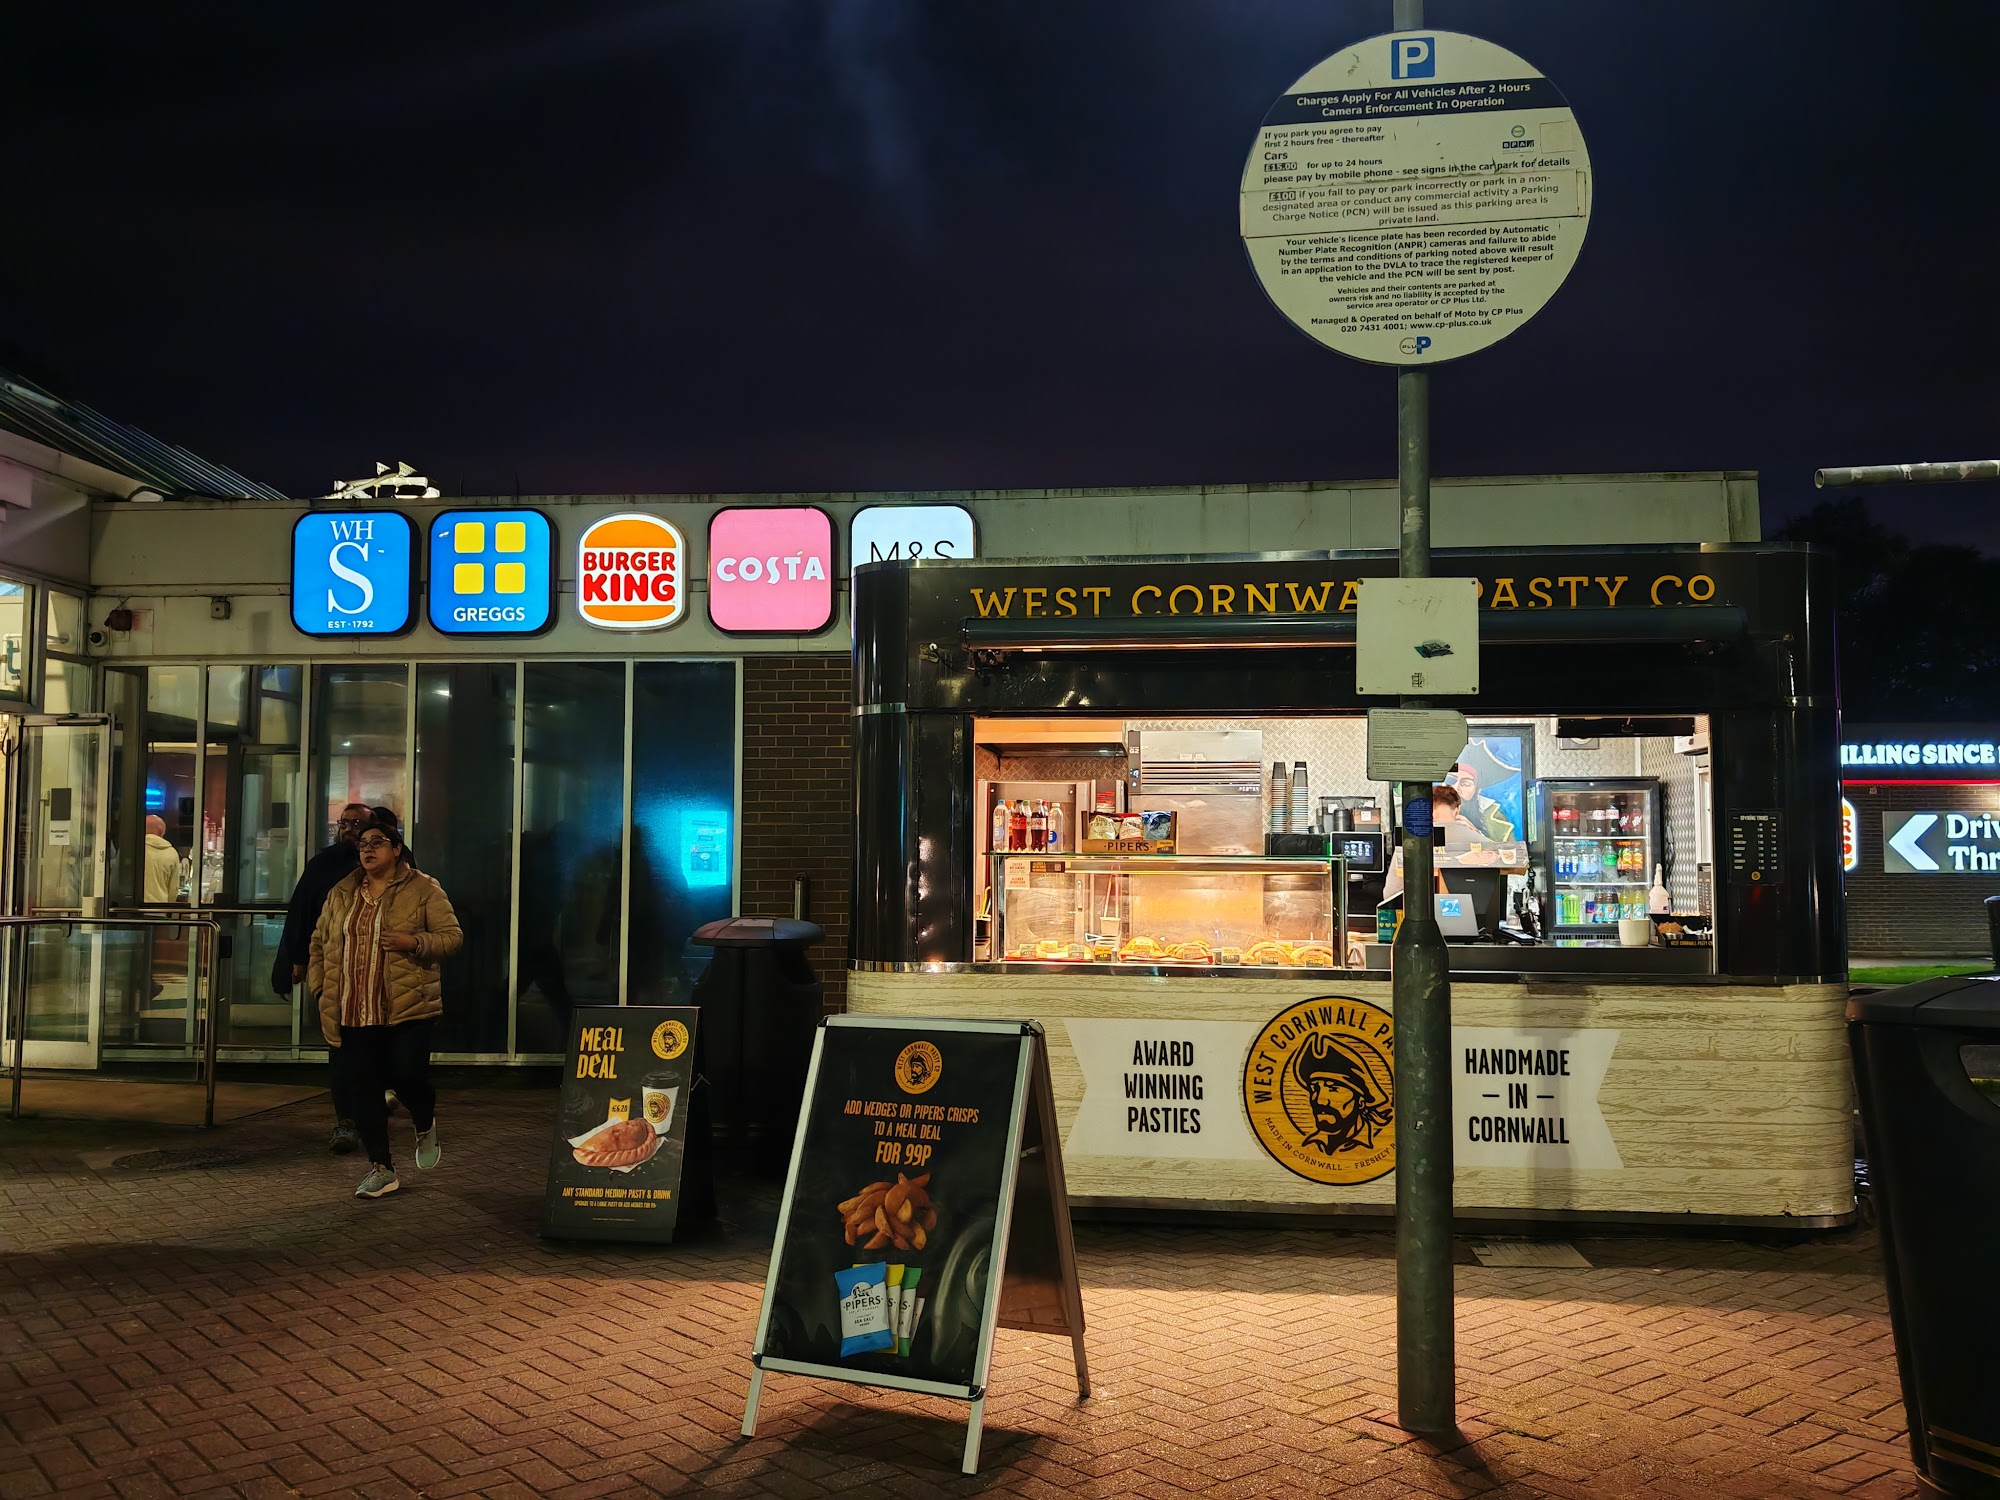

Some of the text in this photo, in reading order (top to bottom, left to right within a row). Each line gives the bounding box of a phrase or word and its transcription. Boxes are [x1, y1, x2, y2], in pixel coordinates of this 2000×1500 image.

[1398, 41, 1429, 78] P
[1297, 84, 1530, 106] Charges Apply For All Vehicles After 2 Hours
[1322, 98, 1504, 116] Camera Enforcement In Operation
[1290, 130, 1309, 138] park
[1329, 128, 1353, 136] agree
[1342, 135, 1384, 143] thereafter
[1264, 152, 1288, 161] Cars
[1264, 176, 1293, 184] please
[1296, 174, 1312, 183] pay
[1316, 172, 1326, 181] by
[1329, 170, 1361, 179] mobile
[1364, 169, 1393, 178] phone
[1421, 166, 1446, 175] signs
[1497, 161, 1518, 171] park
[1521, 160, 1536, 168] for
[1538, 158, 1570, 167] details
[1379, 214, 1439, 226] private land.
[1308, 236, 1346, 244] vehicle's
[1381, 233, 1403, 242] plate
[1448, 228, 1486, 237] recorded
[1490, 227, 1500, 236] by
[1502, 225, 1549, 234] Automatic
[1340, 244, 1392, 252] Recognition
[1394, 241, 1426, 250] (ANPR)
[1469, 237, 1486, 246] and
[1532, 234, 1556, 242] abide
[1458, 280, 1486, 289] parked
[1311, 317, 1348, 325] Managed
[1360, 314, 1399, 323] Operated
[1414, 311, 1441, 320] behalf
[1444, 310, 1452, 318] of
[1478, 309, 1489, 318] by
[1410, 319, 1492, 329] www.cp-plus.co.uk
[330, 520, 374, 540] WH
[583, 552, 675, 572] BURGER
[717, 553, 825, 584] COSTA
[328, 542, 374, 614] S
[583, 574, 675, 602] KING
[970, 586, 1111, 618] WEST
[1131, 581, 1357, 616] CORNWA
[1478, 576, 1628, 608] ASTY
[453, 607, 525, 622] GREGGS
[1841, 744, 1995, 765] ILLING SINCE
[1108, 842, 1149, 851] PIPERS
[1132, 1039, 1194, 1067] AWARD
[1254, 1051, 1277, 1104] WEST
[1270, 1006, 1367, 1049] CORNWALL
[1465, 1048, 1570, 1077] HANDMADE
[1123, 1072, 1203, 1100] WINNING
[1508, 1083, 1527, 1109] IN
[844, 1100, 979, 1124] ADD WEDGES OR PIPERS CRISPS
[1127, 1107, 1201, 1134] PASTIES
[874, 1121, 941, 1140] TO A MEAL DEAL
[1469, 1116, 1570, 1144] CORNWALL
[1265, 1117, 1342, 1170] MADE IN CORNWALL
[875, 1141, 932, 1167] FOR 99P
[1354, 1148, 1390, 1168] FRESHLY
[628, 1189, 646, 1199] PASTY
[653, 1190, 671, 1200] DRINK
[846, 1295, 881, 1311] PIPERS
